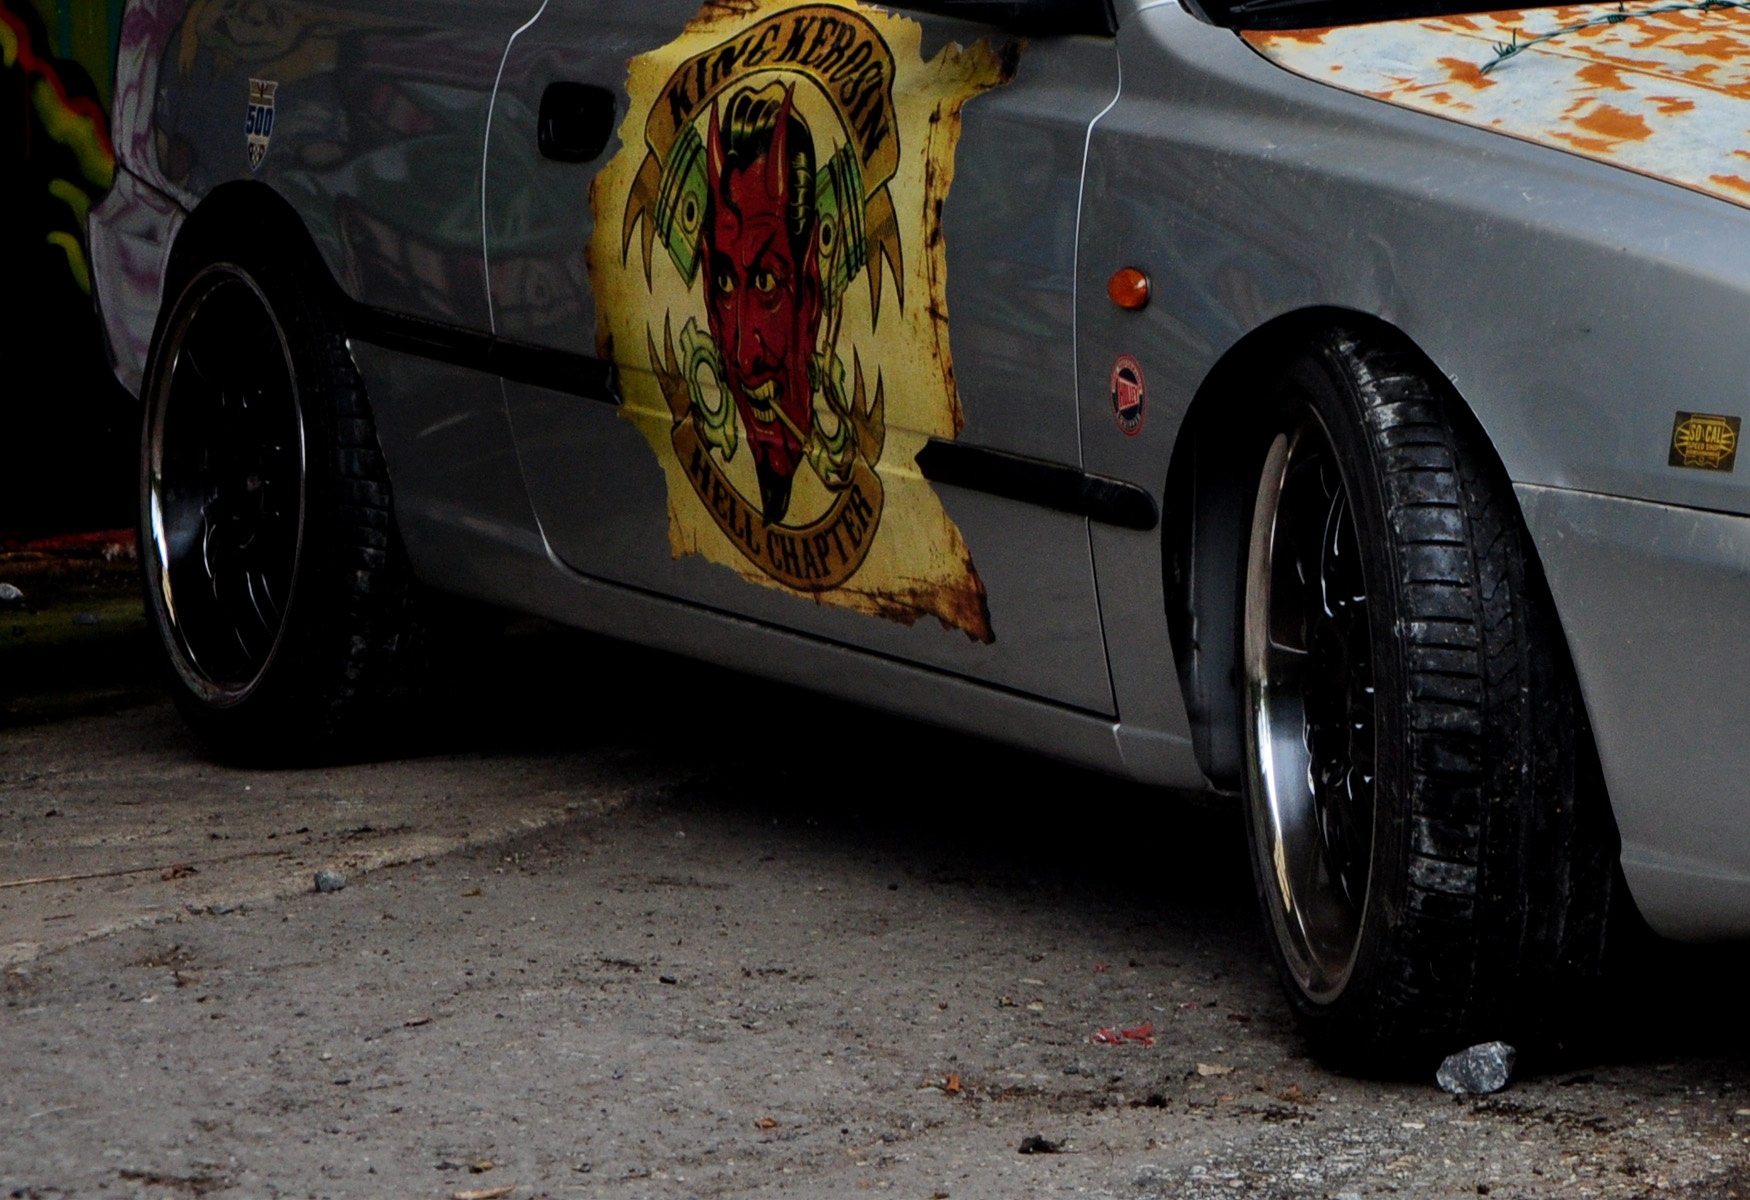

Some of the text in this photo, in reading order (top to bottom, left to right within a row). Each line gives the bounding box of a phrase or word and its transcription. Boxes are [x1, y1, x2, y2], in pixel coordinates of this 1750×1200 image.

[245, 104, 274, 137] 500
[668, 16, 889, 168] KING KEROSIN
[690, 445, 873, 578] HELL CHAPTER
